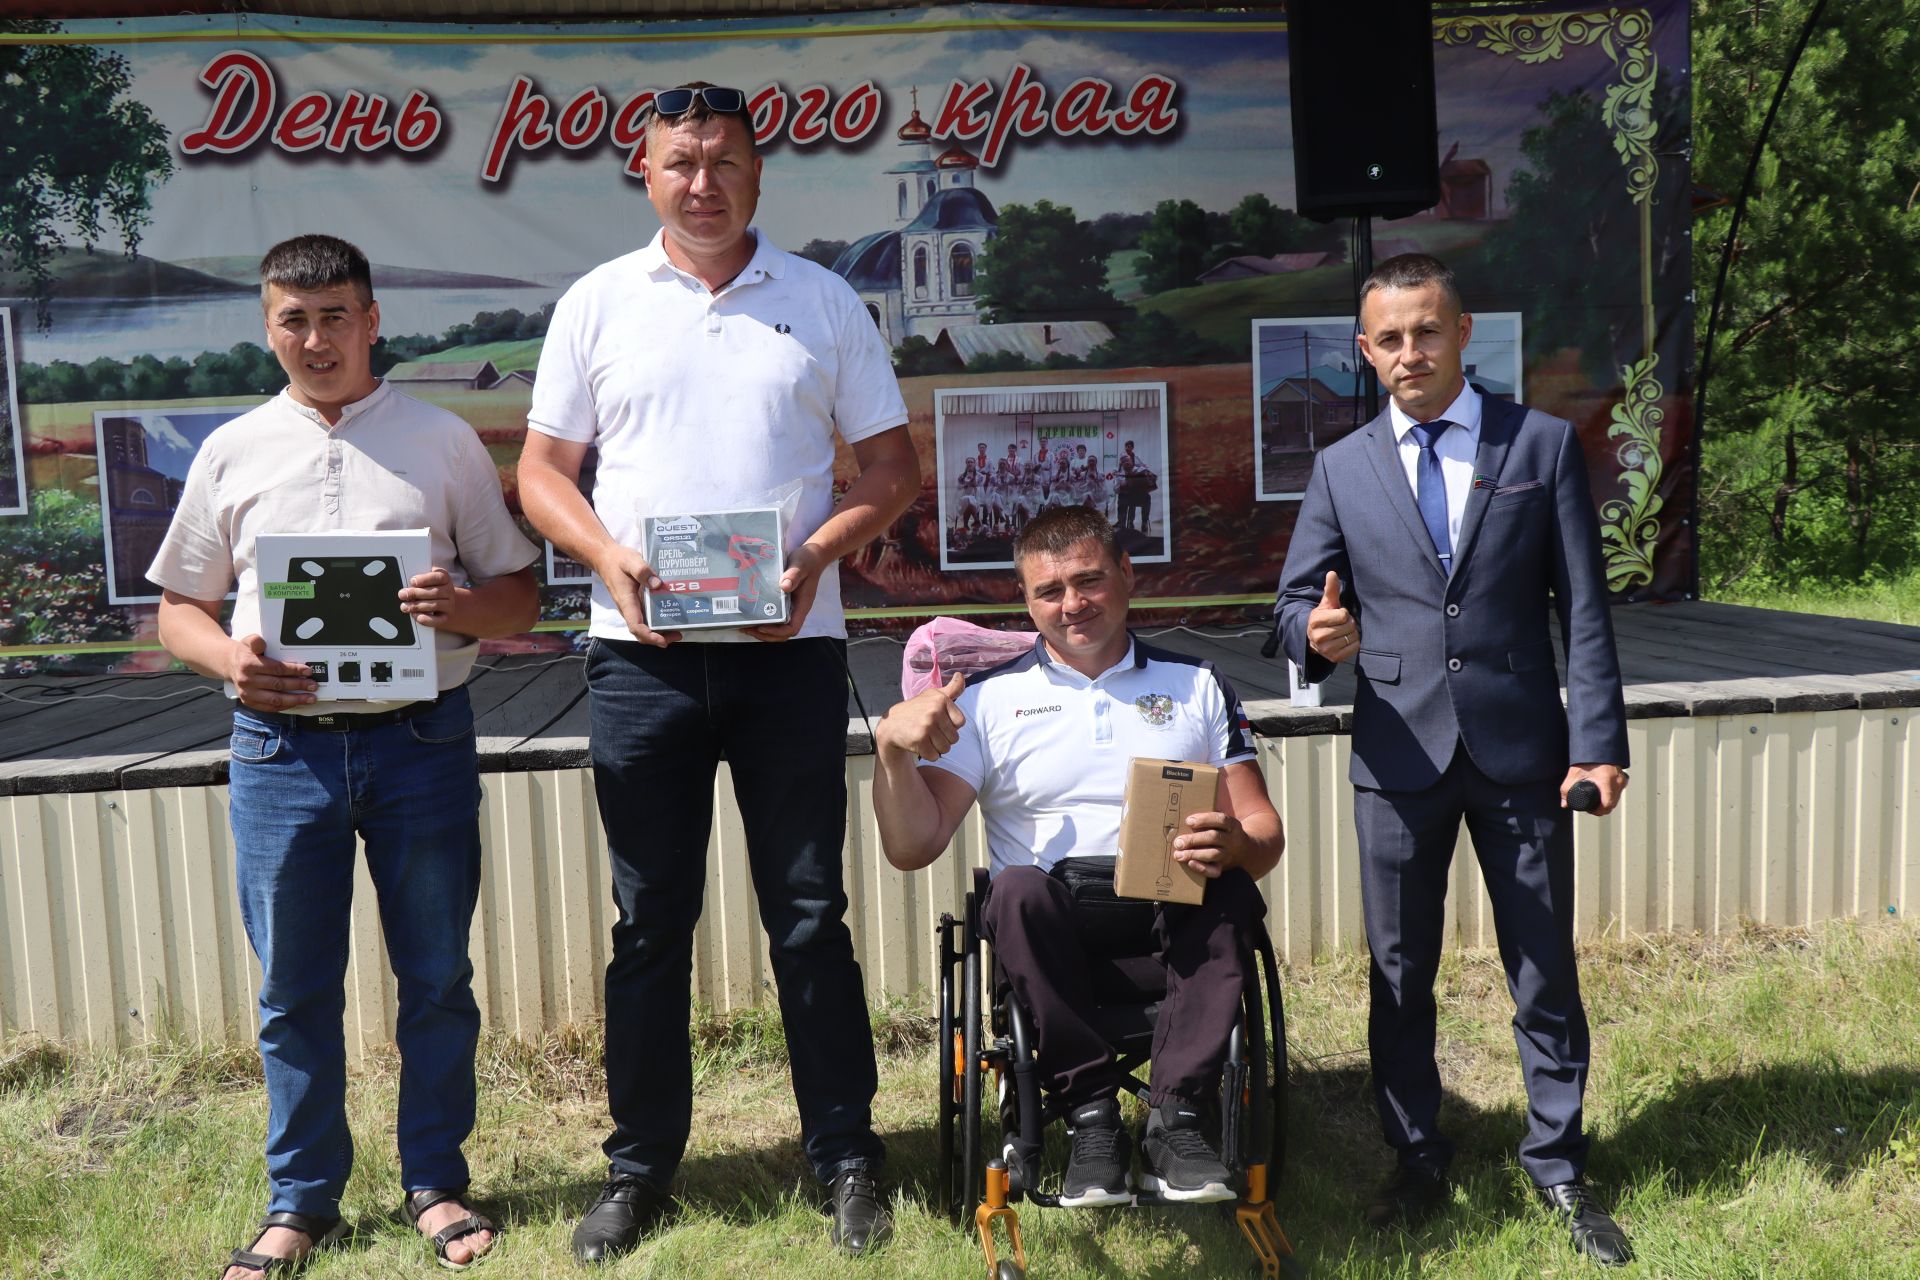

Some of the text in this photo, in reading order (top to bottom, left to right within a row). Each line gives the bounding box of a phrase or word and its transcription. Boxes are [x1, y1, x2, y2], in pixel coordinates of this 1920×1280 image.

[179, 49, 1179, 182] День родого края
[669, 582, 686, 591] 12
[1015, 705, 1062, 718] FORWARD
